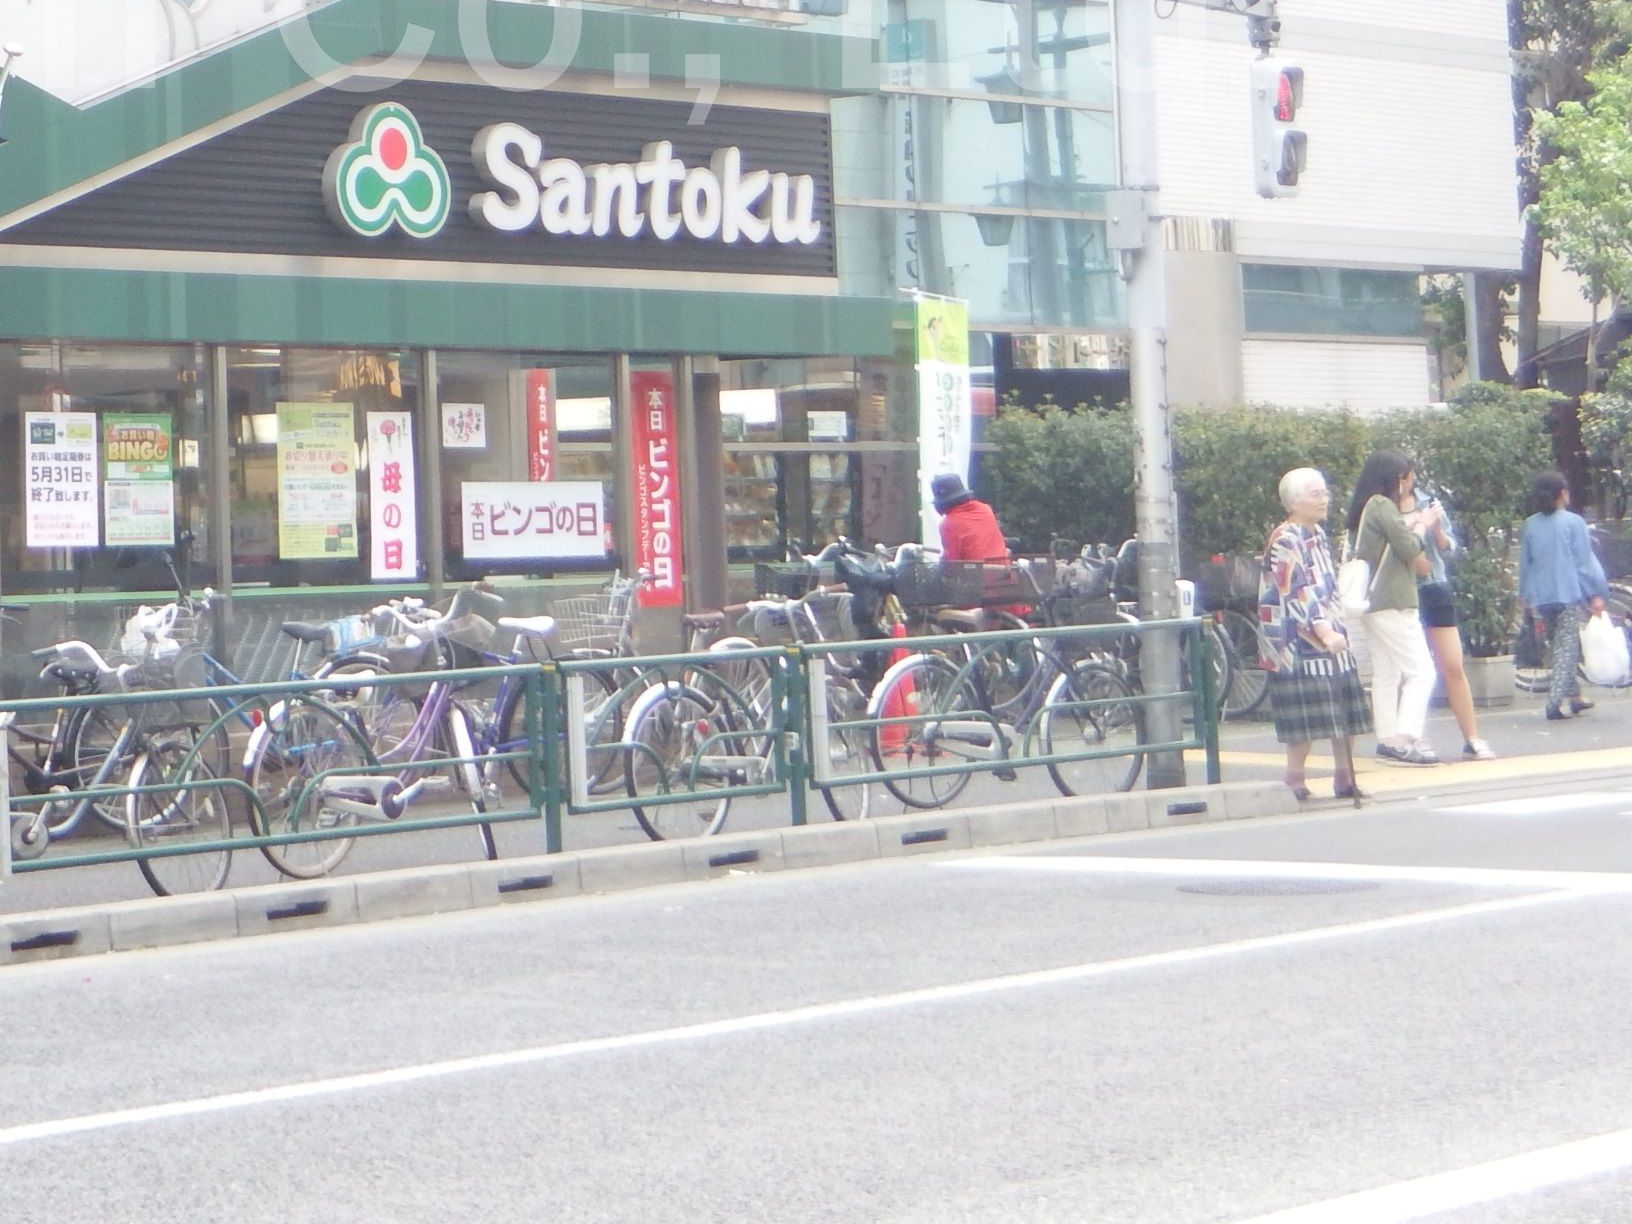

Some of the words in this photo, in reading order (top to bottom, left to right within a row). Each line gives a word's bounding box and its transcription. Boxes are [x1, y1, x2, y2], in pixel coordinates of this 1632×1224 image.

[470, 122, 821, 244] Santoku
[108, 441, 168, 461] BINGO
[31, 466, 92, 483] 5月31日で
[380, 462, 403, 570] 母の日
[489, 501, 598, 537] ビンゴの日
